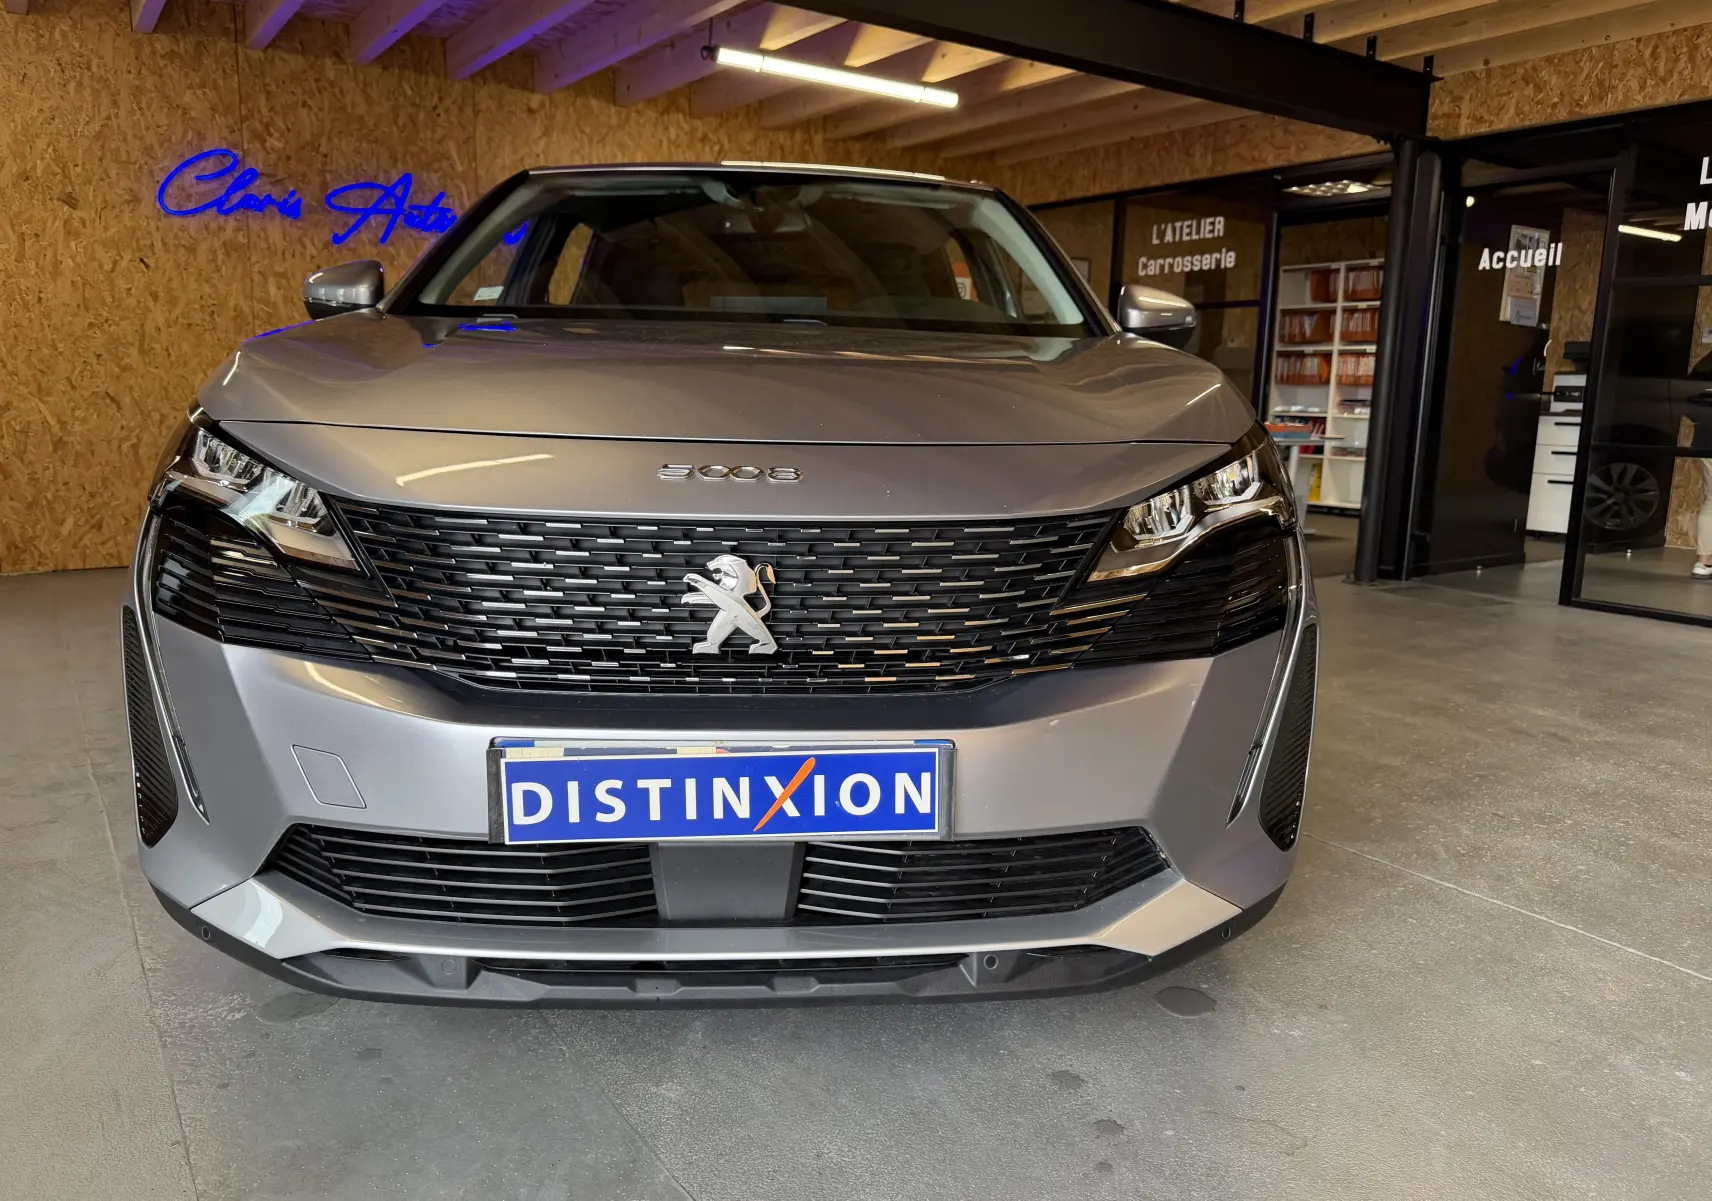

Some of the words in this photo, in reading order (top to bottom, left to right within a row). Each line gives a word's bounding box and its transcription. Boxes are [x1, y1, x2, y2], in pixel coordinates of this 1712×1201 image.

[1151, 216, 1225, 245] L'ATELIER
[1137, 247, 1237, 276] Carrosserie
[1478, 242, 1563, 271] Accueil
[657, 463, 803, 483] 5008
[511, 757, 931, 832] DISTINXION
